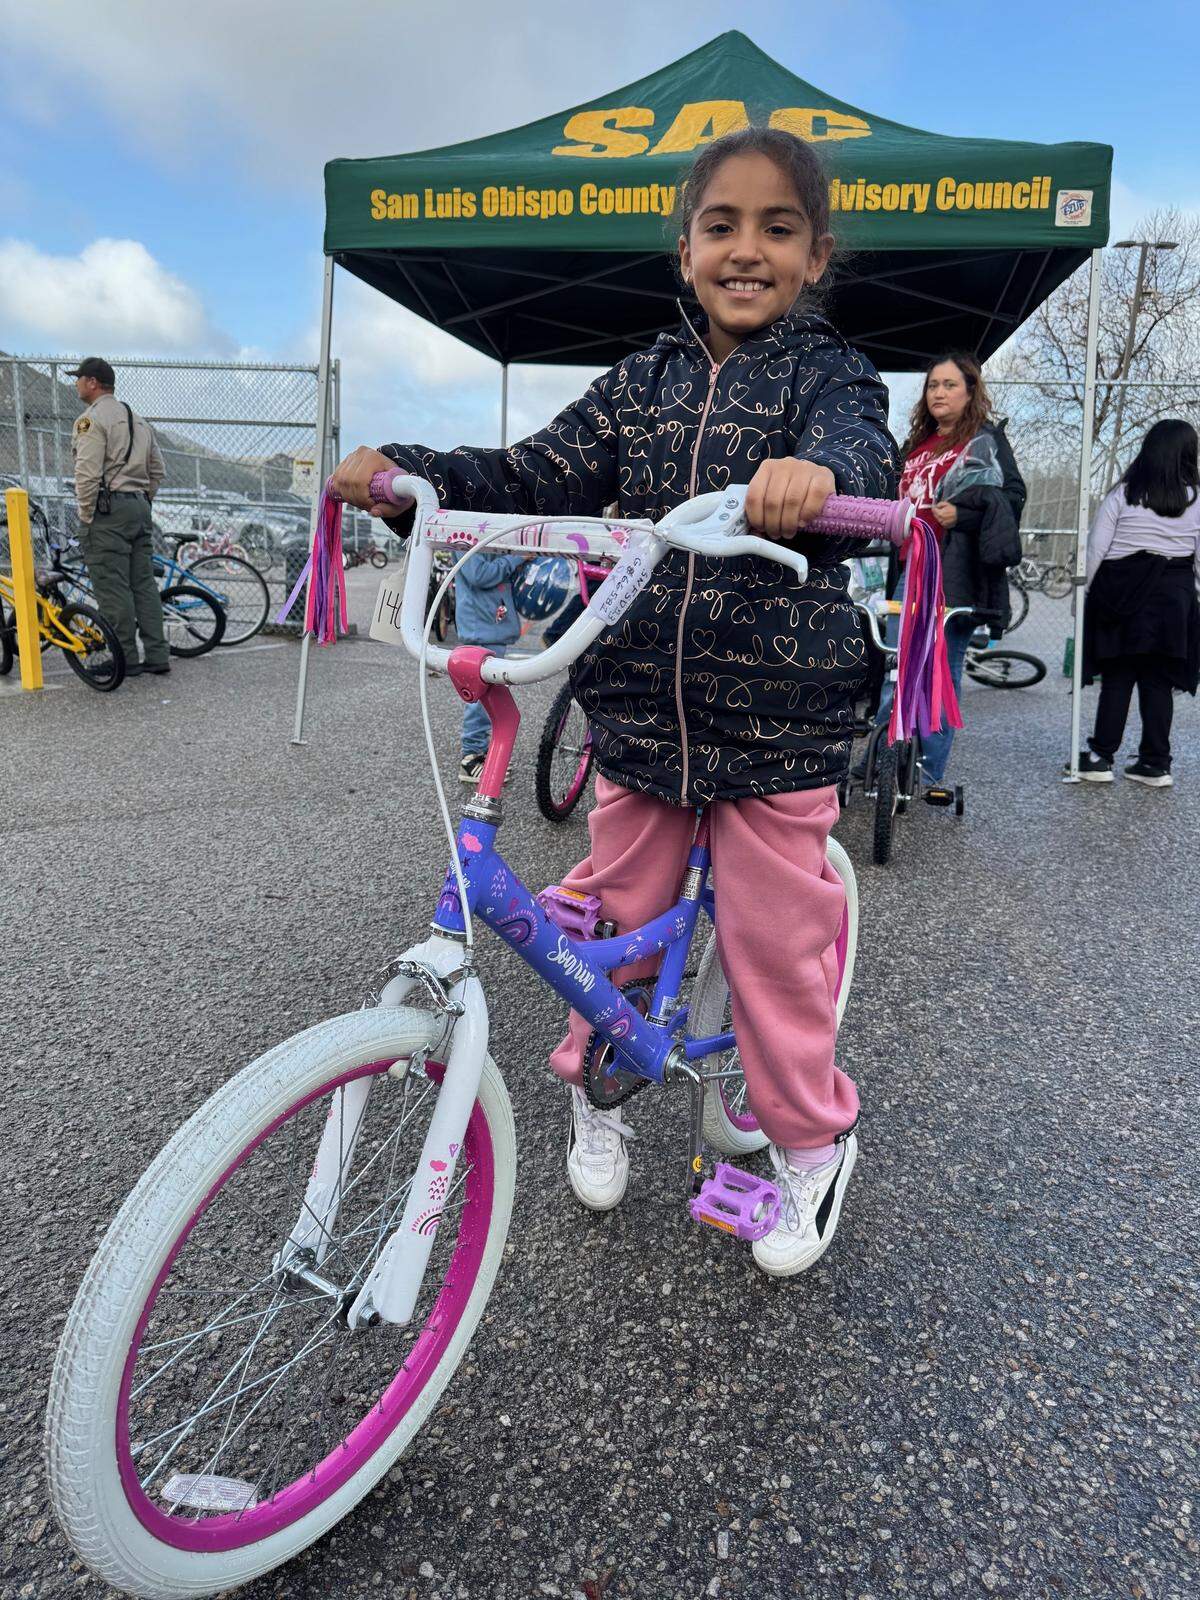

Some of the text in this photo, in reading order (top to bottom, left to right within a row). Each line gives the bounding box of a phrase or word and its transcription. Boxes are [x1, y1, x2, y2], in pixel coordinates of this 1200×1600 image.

[551, 100, 873, 158] SAC
[371, 190, 419, 219] San
[424, 188, 476, 218] Luis
[482, 185, 574, 219] Obispo
[580, 183, 677, 216] County
[828, 178, 932, 213] dvisory
[935, 176, 1052, 211] Council
[765, 597, 800, 628] love
[632, 662, 662, 694] love
[683, 672, 718, 703] love
[764, 679, 801, 711] love
[629, 736, 659, 767] love
[547, 933, 596, 993] Soarin
